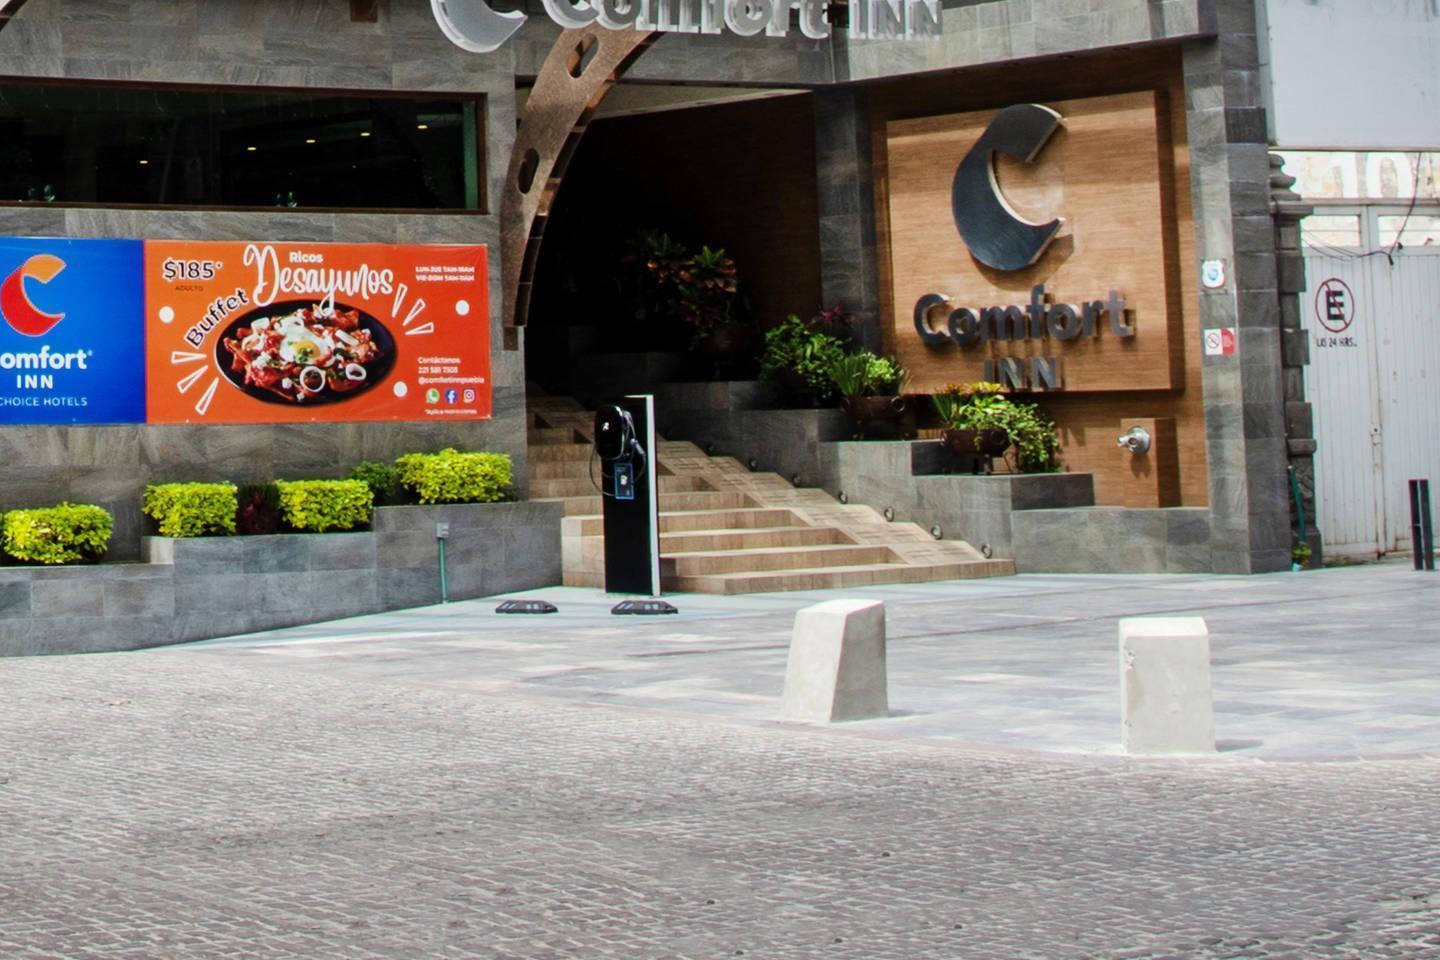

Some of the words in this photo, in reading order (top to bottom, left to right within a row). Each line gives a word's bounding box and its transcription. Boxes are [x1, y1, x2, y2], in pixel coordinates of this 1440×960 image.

[288, 250, 324, 264] Ricos
[243, 244, 394, 317] Desayunos
[183, 287, 251, 350] Buffet
[913, 283, 1136, 345] Comfort
[16, 374, 54, 389] INN
[983, 355, 1062, 390] INN
[44, 397, 88, 407] HOTELS
